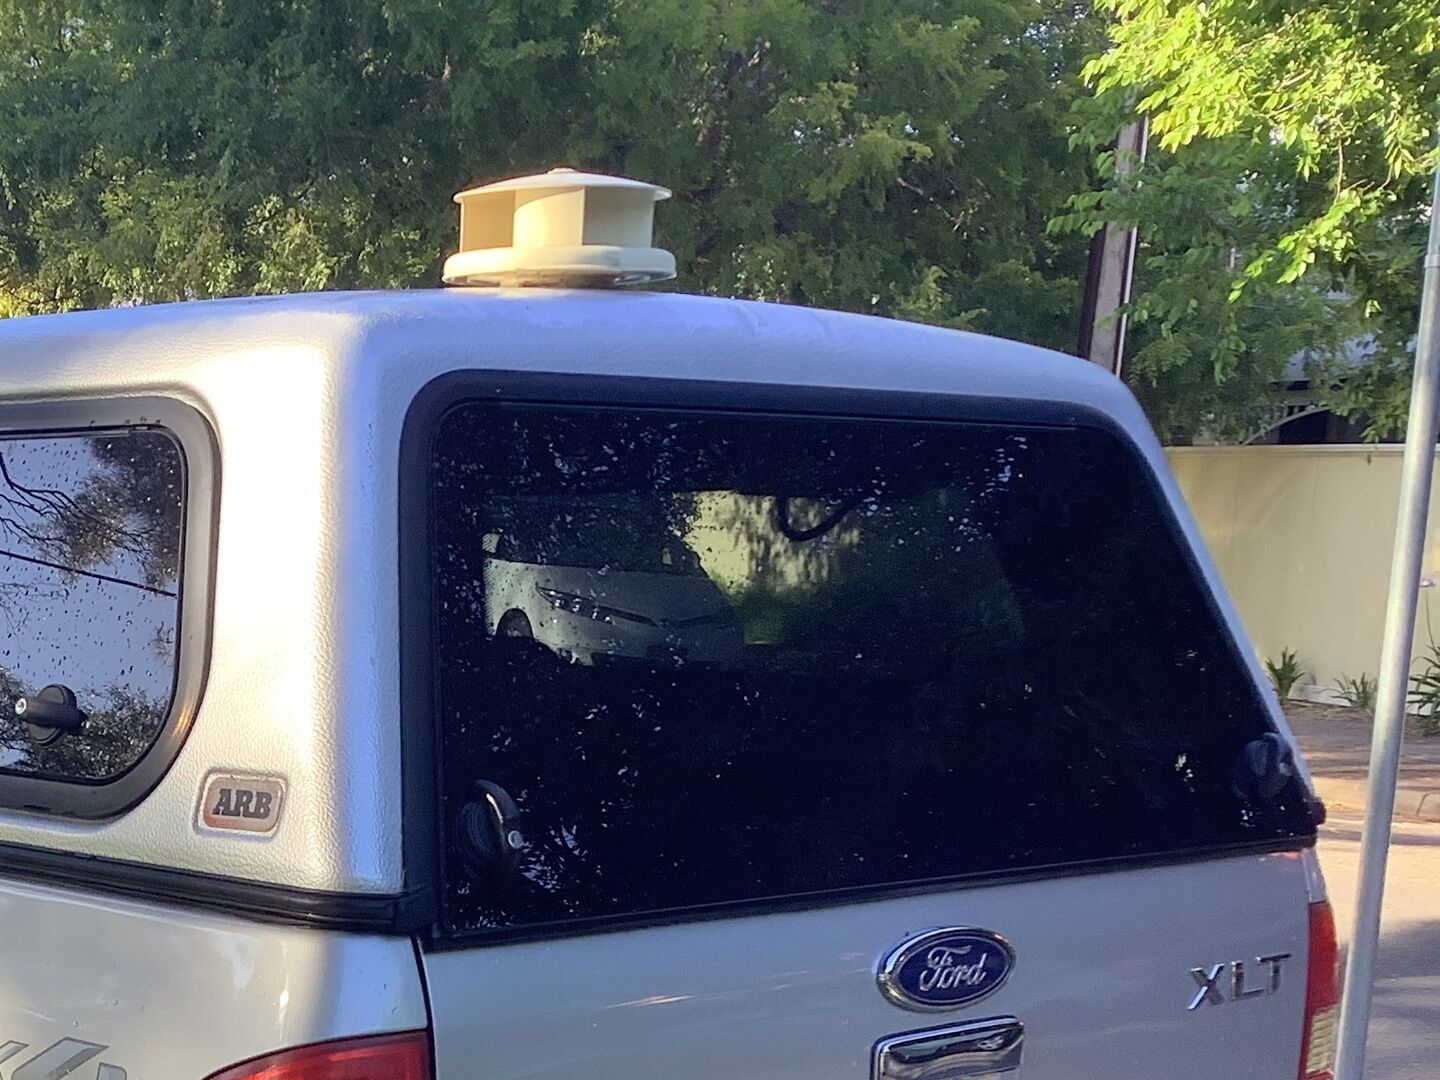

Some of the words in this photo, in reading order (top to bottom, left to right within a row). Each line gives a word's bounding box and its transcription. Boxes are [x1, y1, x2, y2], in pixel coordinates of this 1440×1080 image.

[212, 788, 272, 819] ARB
[919, 945, 988, 992] Ford
[1187, 953, 1292, 1010] XLT
